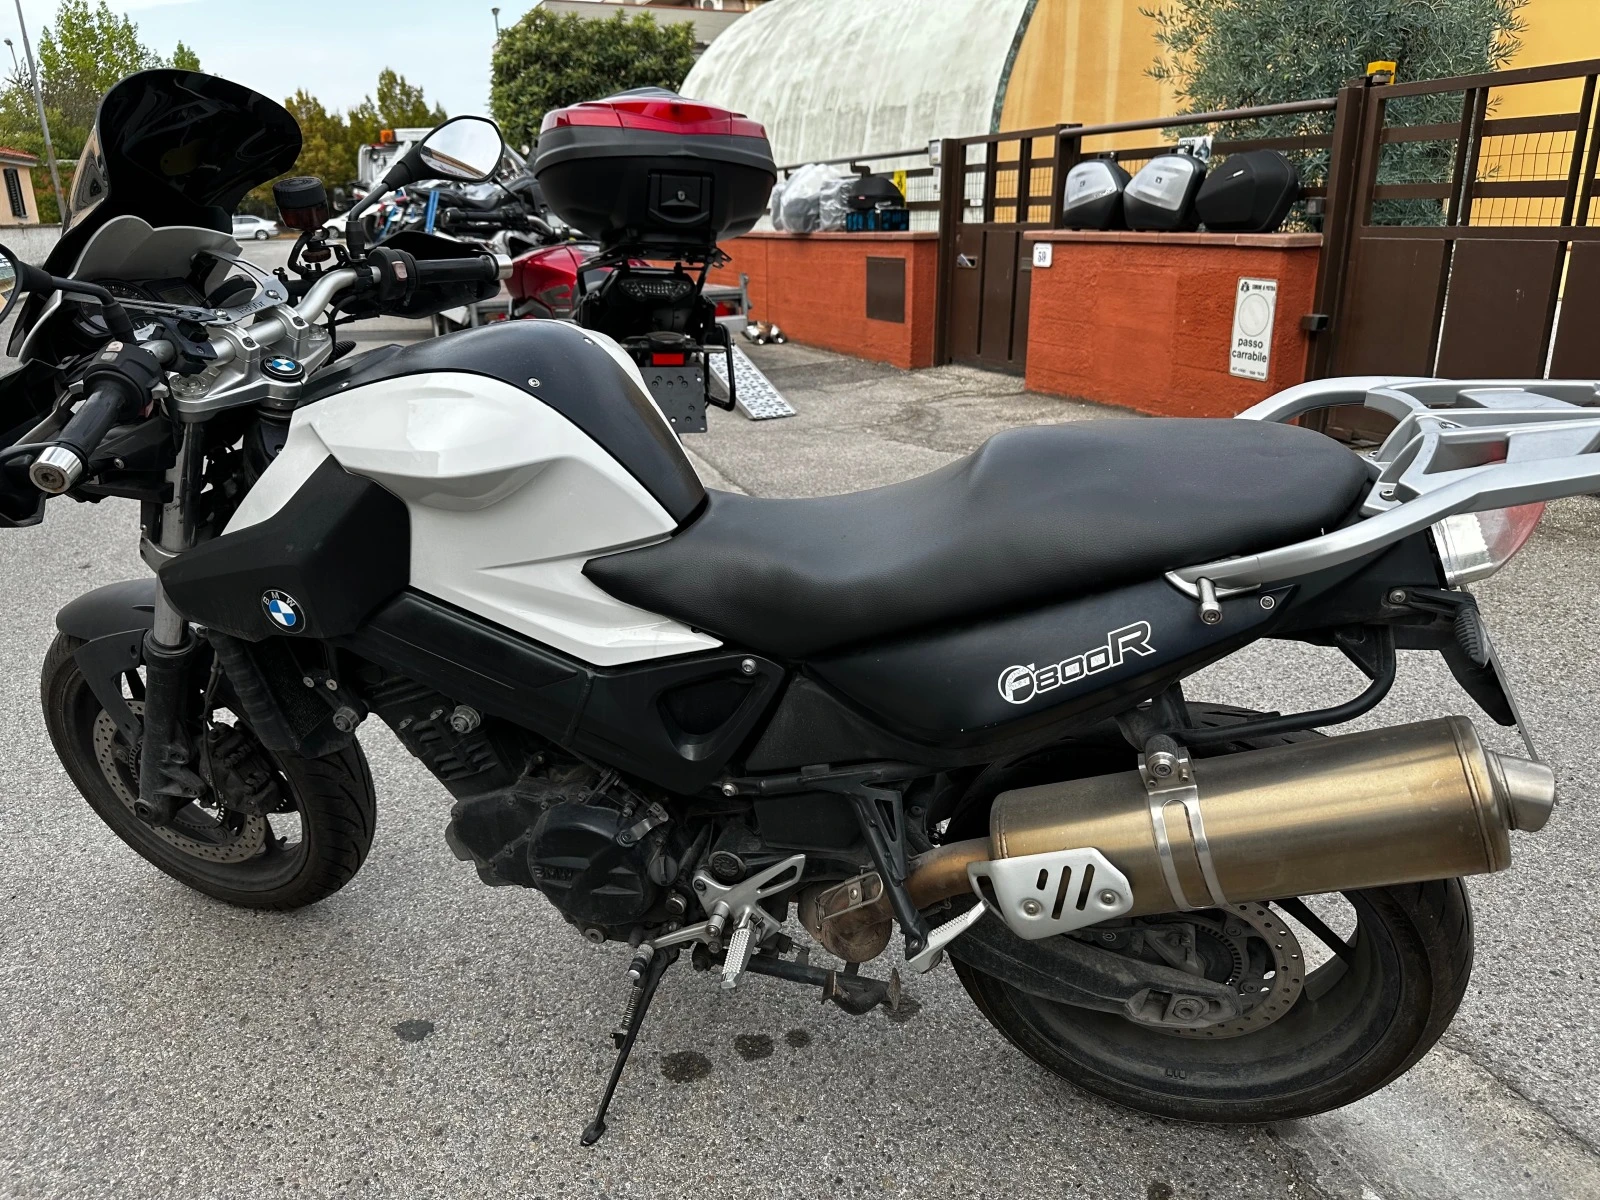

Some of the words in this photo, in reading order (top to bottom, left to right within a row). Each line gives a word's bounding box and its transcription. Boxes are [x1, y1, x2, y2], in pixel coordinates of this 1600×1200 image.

[1237, 338, 1264, 349] passo
[1231, 350, 1268, 363] carrabile
[263, 592, 295, 607] BMW
[998, 620, 1157, 705] F800R
